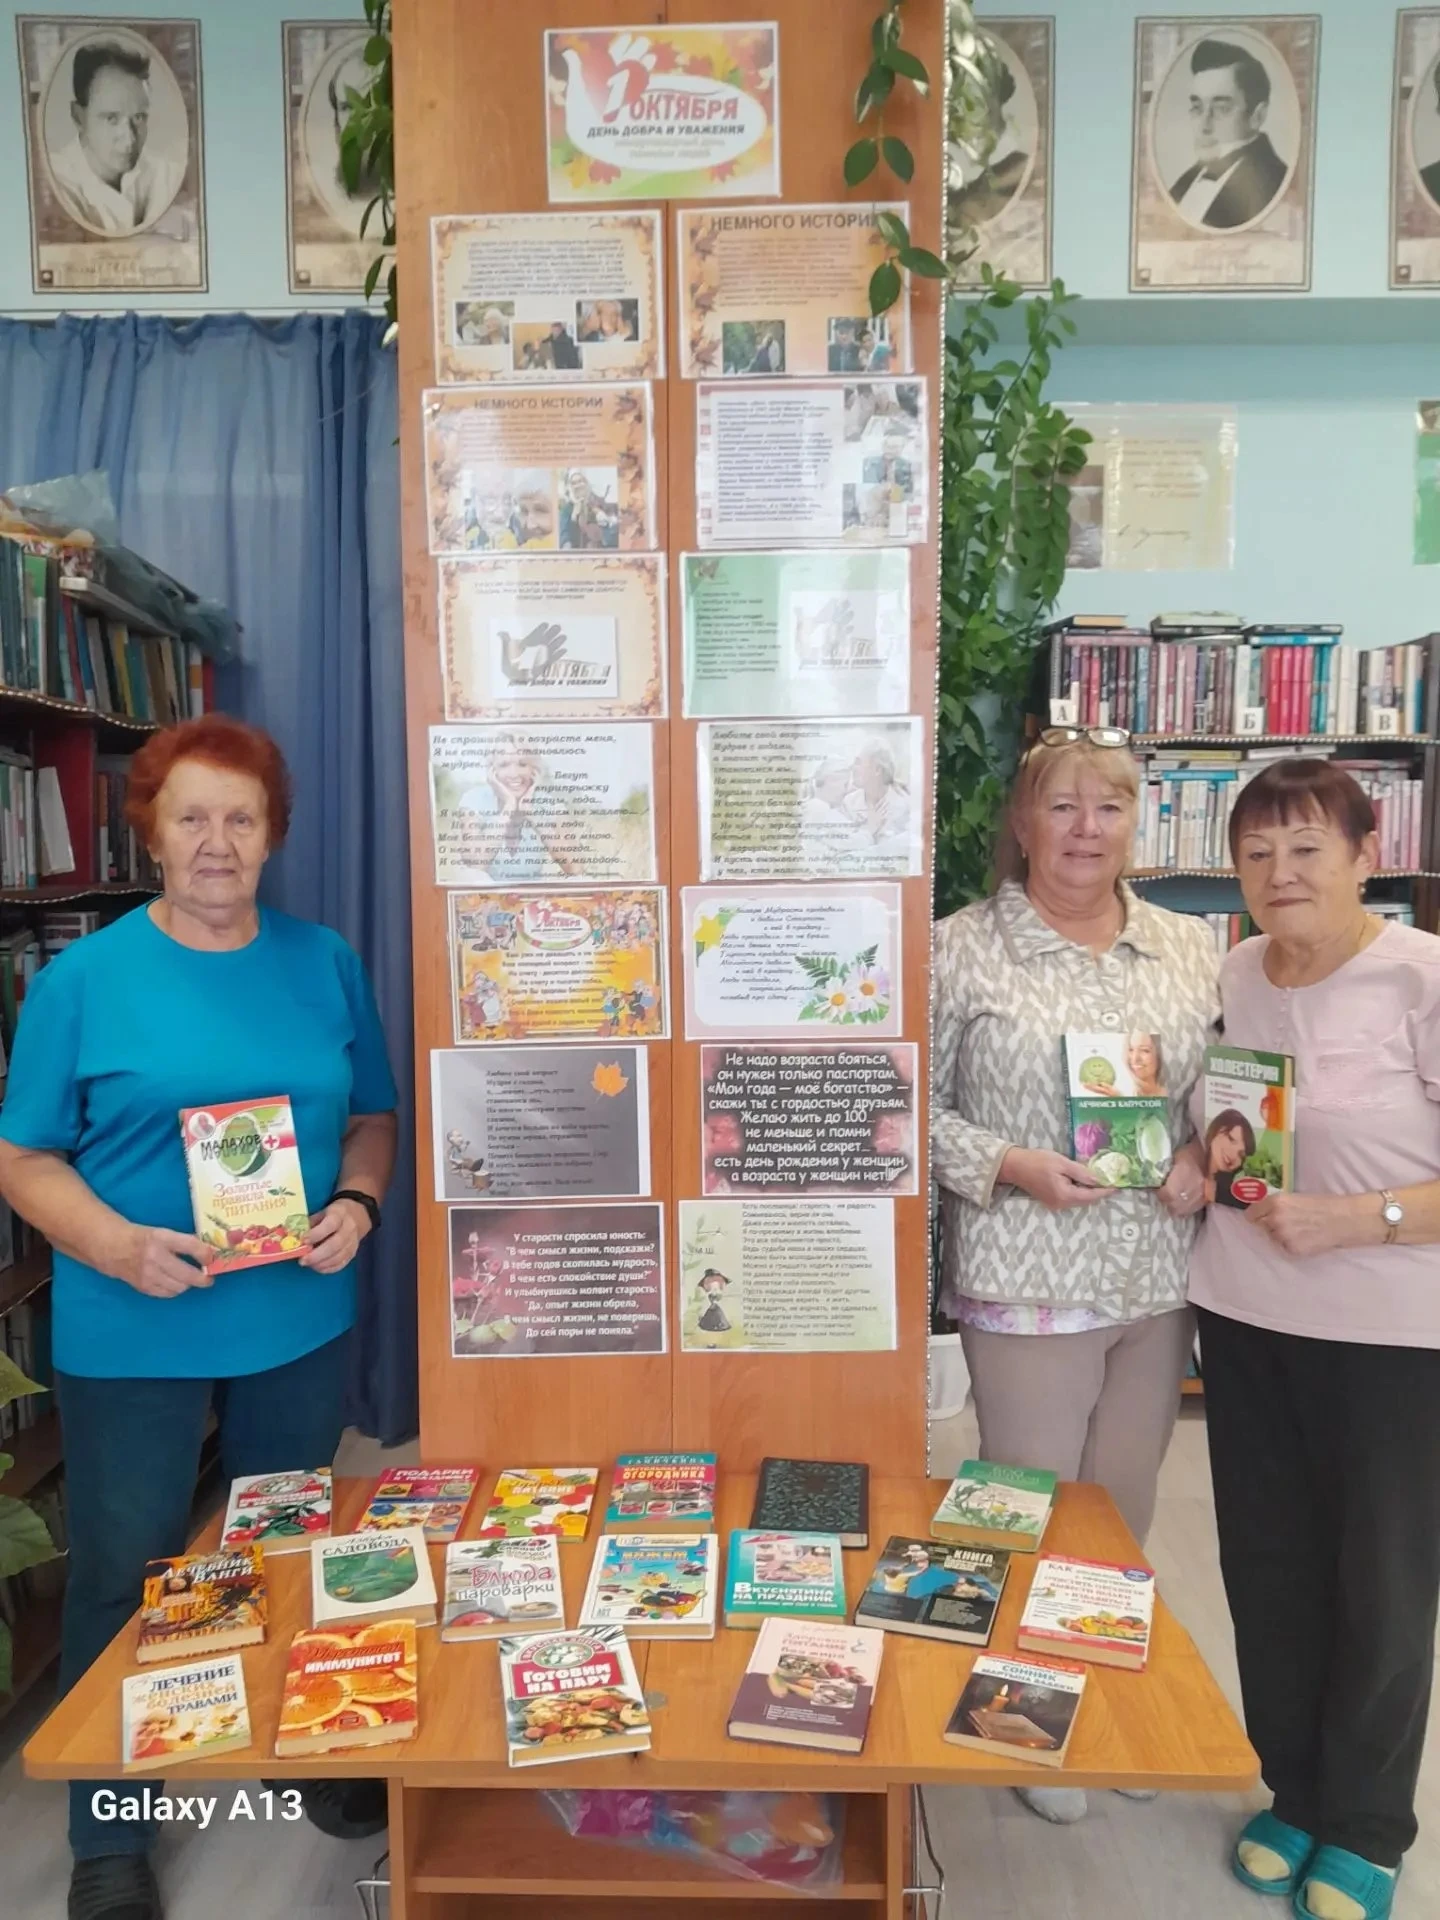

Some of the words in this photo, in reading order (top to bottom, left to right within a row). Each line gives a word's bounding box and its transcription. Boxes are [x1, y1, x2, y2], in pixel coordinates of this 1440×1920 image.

[629, 93, 740, 121] ОКТЯБРЯ
[587, 126, 620, 138] ДЕНЬ
[621, 125, 663, 137] ДОБРА
[677, 123, 746, 136] УВАЖЕНИЯ
[711, 214, 795, 232] НЕМНОГО
[541, 396, 603, 409] ИСТОРИИ
[1056, 703, 1069, 722] А
[1243, 713, 1255, 729] Б
[1379, 713, 1391, 731] В
[726, 1053, 744, 1065] Не
[746, 1055, 777, 1068] надо
[780, 1054, 835, 1069] возраста
[838, 1051, 891, 1067] бояться,
[717, 1069, 734, 1080] он
[736, 1069, 776, 1083] нужен
[778, 1069, 823, 1080] только
[826, 1068, 898, 1083] паспортам.
[1209, 1056, 1281, 1082] ХОЛЕСТЕРИН
[707, 1081, 744, 1096] «Мои
[747, 1085, 777, 1097] года
[794, 1081, 821, 1094] моё
[823, 1081, 894, 1094] богатство»
[709, 1099, 747, 1110] скажи
[751, 1099, 768, 1109] ты
[771, 1100, 778, 1109] с
[781, 1098, 850, 1112] гордостью
[852, 1098, 908, 1113] друзьям.
[740, 1110, 786, 1124] Желаю
[790, 1112, 822, 1124] жить
[824, 1112, 842, 1126] до
[745, 1128, 762, 1138] не
[763, 1127, 813, 1138] меньше
[816, 1127, 826, 1137] и
[829, 1127, 872, 1138] помни
[746, 1140, 817, 1153] маленький
[714, 1157, 742, 1167] есть
[744, 1156, 774, 1168] день
[777, 1155, 839, 1171] рождения
[841, 1156, 850, 1170] у
[731, 1172, 740, 1182] а
[742, 1171, 797, 1185] возраста
[799, 1172, 807, 1184] у
[810, 1170, 861, 1184] женщин
[225, 1197, 288, 1219] ПИТАНИЯ
[521, 1233, 563, 1244] старости
[564, 1231, 608, 1243] спросила
[537, 1247, 567, 1256] смысл
[603, 1243, 656, 1255] подскажи?
[511, 1260, 532, 1270] тебе
[534, 1260, 561, 1271] годов
[562, 1259, 611, 1269] скопилась
[537, 1274, 557, 1283] есть
[558, 1272, 618, 1283] спокойствие
[513, 1287, 578, 1298] улыбнувшись
[579, 1286, 614, 1296] молвит
[614, 1286, 658, 1297] старость:
[545, 1300, 570, 1311] опыт
[571, 1300, 602, 1310] жизни
[602, 1299, 640, 1310] обрела,
[531, 1314, 561, 1324] смысл
[610, 1312, 660, 1324] поверишь,
[526, 1328, 540, 1339] До
[540, 1326, 557, 1337] сей
[558, 1326, 584, 1338] поры
[585, 1327, 596, 1336] не
[395, 1467, 475, 1478] ПОДАРКИ
[622, 1470, 705, 1480] ОГОРОДНИКА
[321, 1537, 412, 1557] САДОВОДА
[953, 1549, 994, 1564] КНИГА
[471, 1564, 555, 1588] Блюда
[456, 1582, 556, 1608] пароварки
[757, 1591, 835, 1603] ПРАЗДНИК
[149, 1664, 236, 1692] ЛЕЧЕНИЕ
[1001, 1664, 1058, 1682] СОННИК
[527, 1681, 556, 1694] НА
[559, 1673, 612, 1691] ПАРУ
[166, 1692, 239, 1716] ТРАВАМИ
